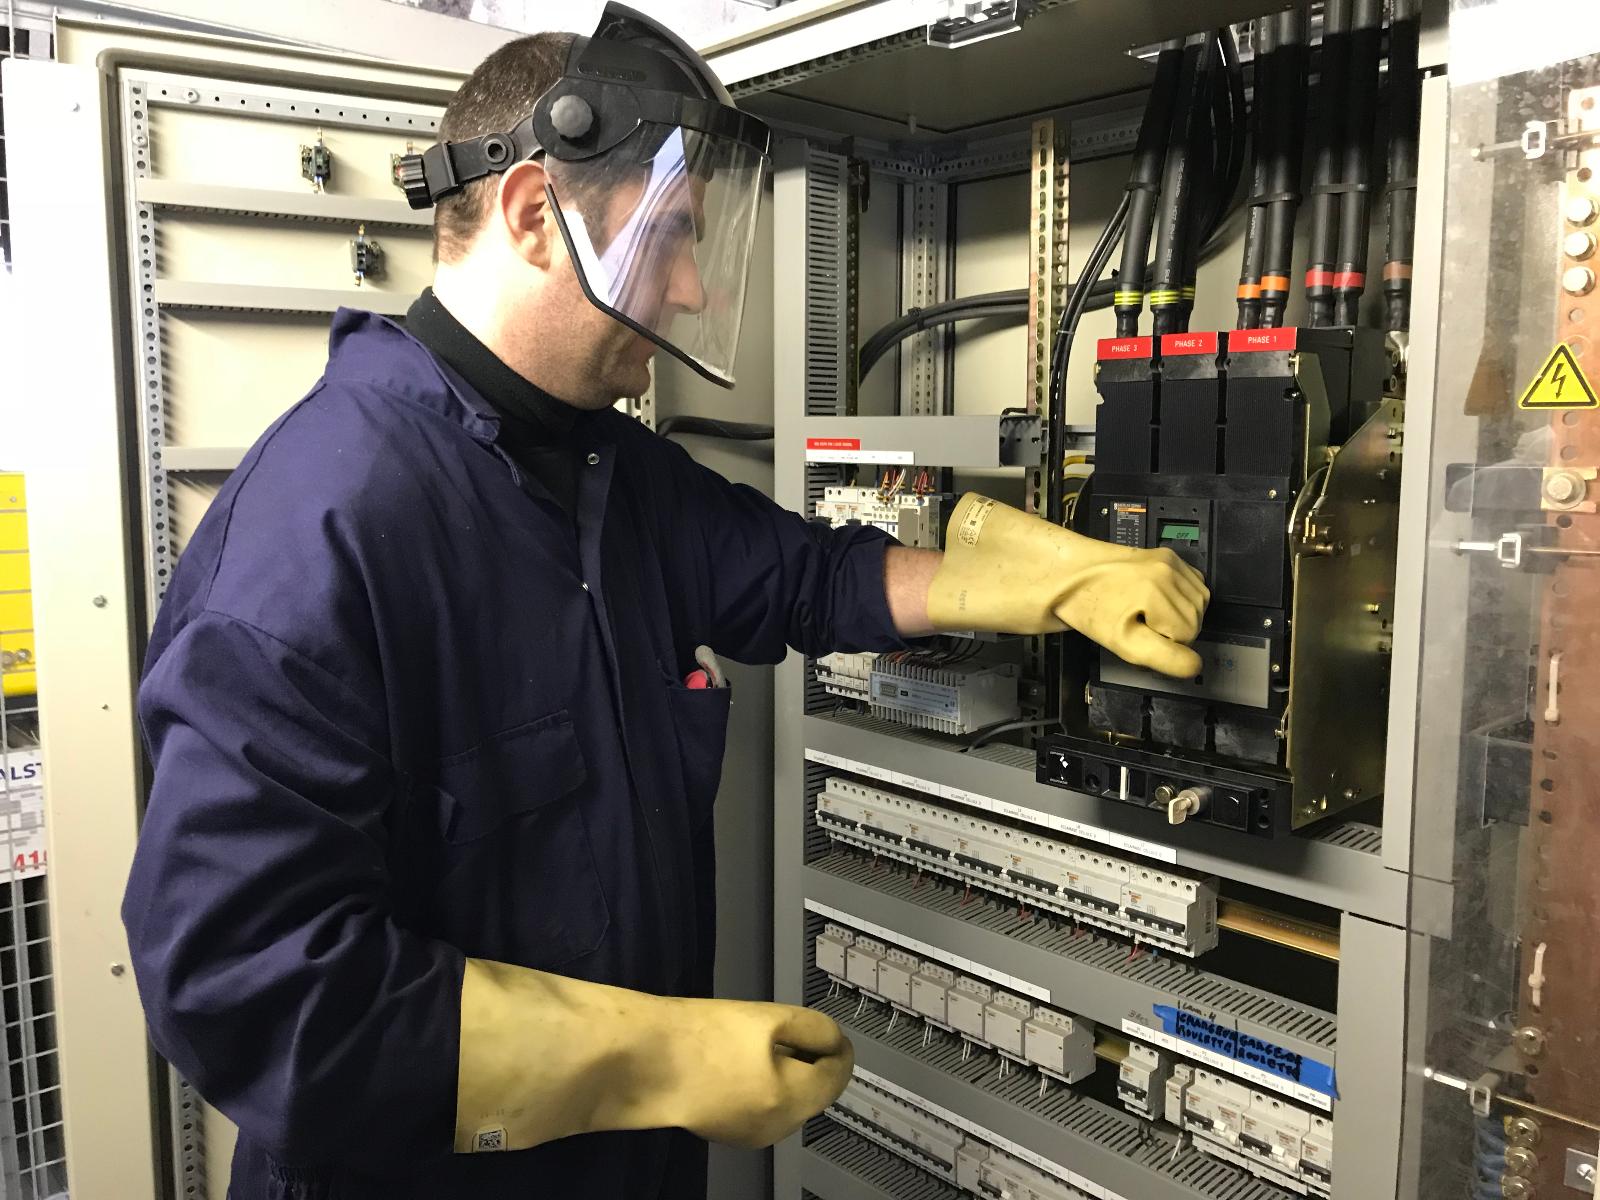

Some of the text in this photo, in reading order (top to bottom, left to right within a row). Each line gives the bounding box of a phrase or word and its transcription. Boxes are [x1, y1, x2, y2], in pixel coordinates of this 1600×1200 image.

[1174, 339, 1203, 348] PHASE 2
[1247, 335, 1278, 344] PHASE 1
[1111, 344, 1138, 353] PHASE 3
